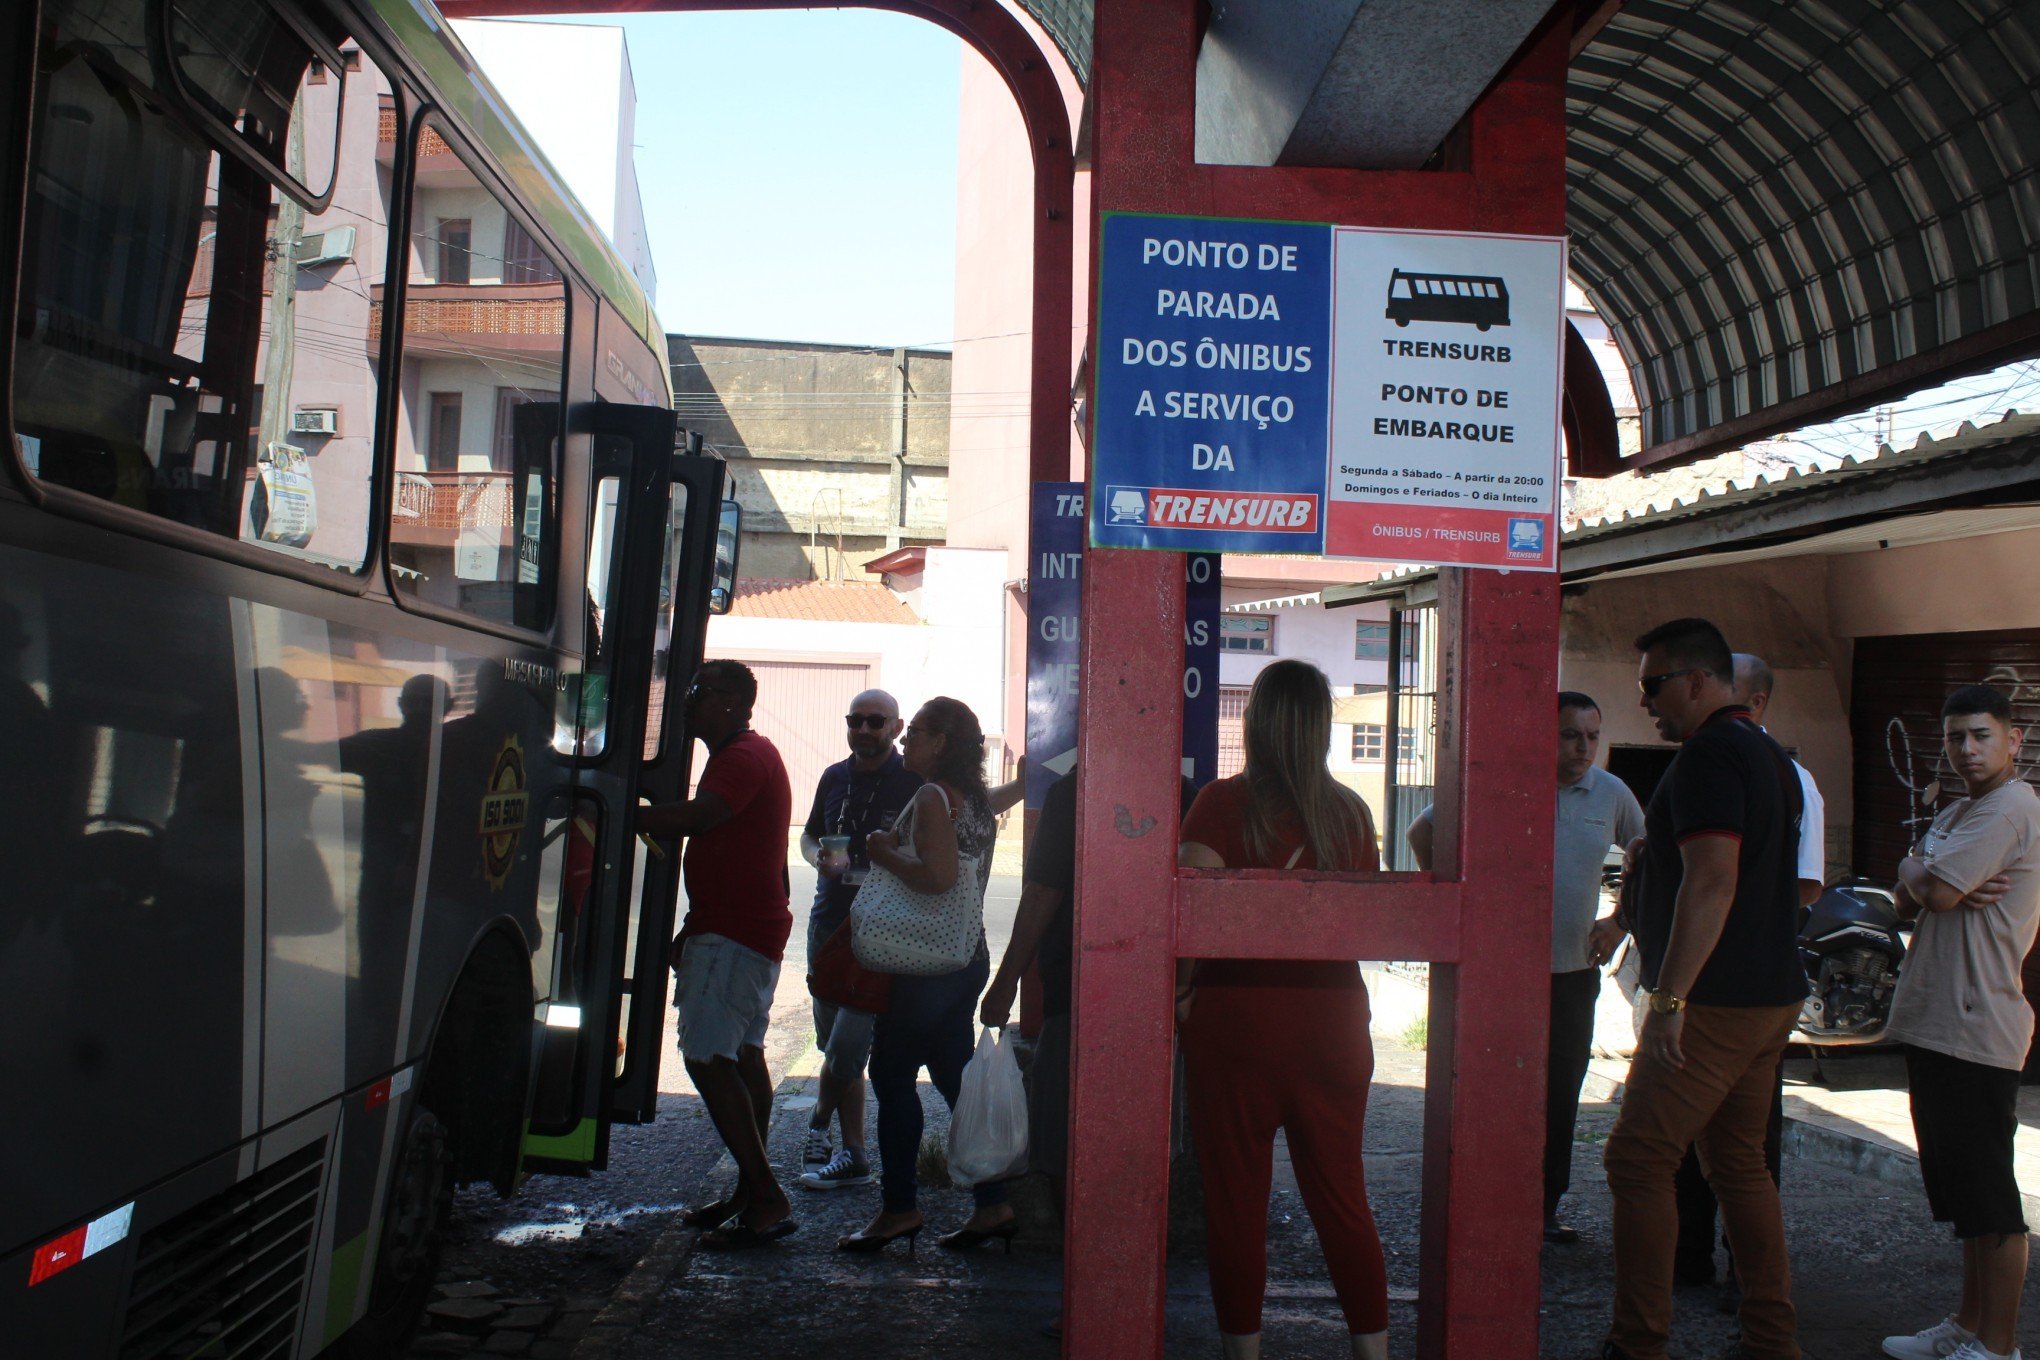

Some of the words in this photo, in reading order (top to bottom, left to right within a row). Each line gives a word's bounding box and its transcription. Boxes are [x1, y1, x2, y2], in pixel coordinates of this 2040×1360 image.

[1143, 238, 1249, 270] PONTO
[1257, 244, 1297, 271] DE
[1157, 289, 1280, 321] PARADA
[1122, 338, 1187, 368] DOS
[1195, 336, 1312, 373] ÔNIBUS
[1383, 339, 1512, 363] TRENSURB
[1381, 383, 1468, 406] PONTO
[1476, 389, 1509, 409] DE
[1134, 390, 1157, 417] A
[1164, 391, 1294, 430] SERVIÇO
[1373, 417, 1514, 443] EMBARQUE
[1192, 443, 1235, 472] DA
[1340, 465, 1388, 478] Segunda
[1391, 469, 1399, 477] a
[1402, 468, 1443, 480] Sábado
[1454, 472, 1462, 481] A
[1465, 473, 1494, 484] partir
[1497, 475, 1511, 484] da
[1514, 476, 1544, 487] 20:00
[1344, 483, 1399, 496] Domingos
[1402, 487, 1410, 496] e
[1413, 487, 1460, 499] Feriados
[1471, 491, 1480, 500] O
[1483, 491, 1499, 501] dia
[1502, 493, 1538, 504] Inteiro
[1152, 494, 1313, 528] TRENSURB
[1433, 528, 1501, 543] TRENSURB
[1508, 551, 1542, 559] TRENSURB
[484, 799, 502, 828] ISO
